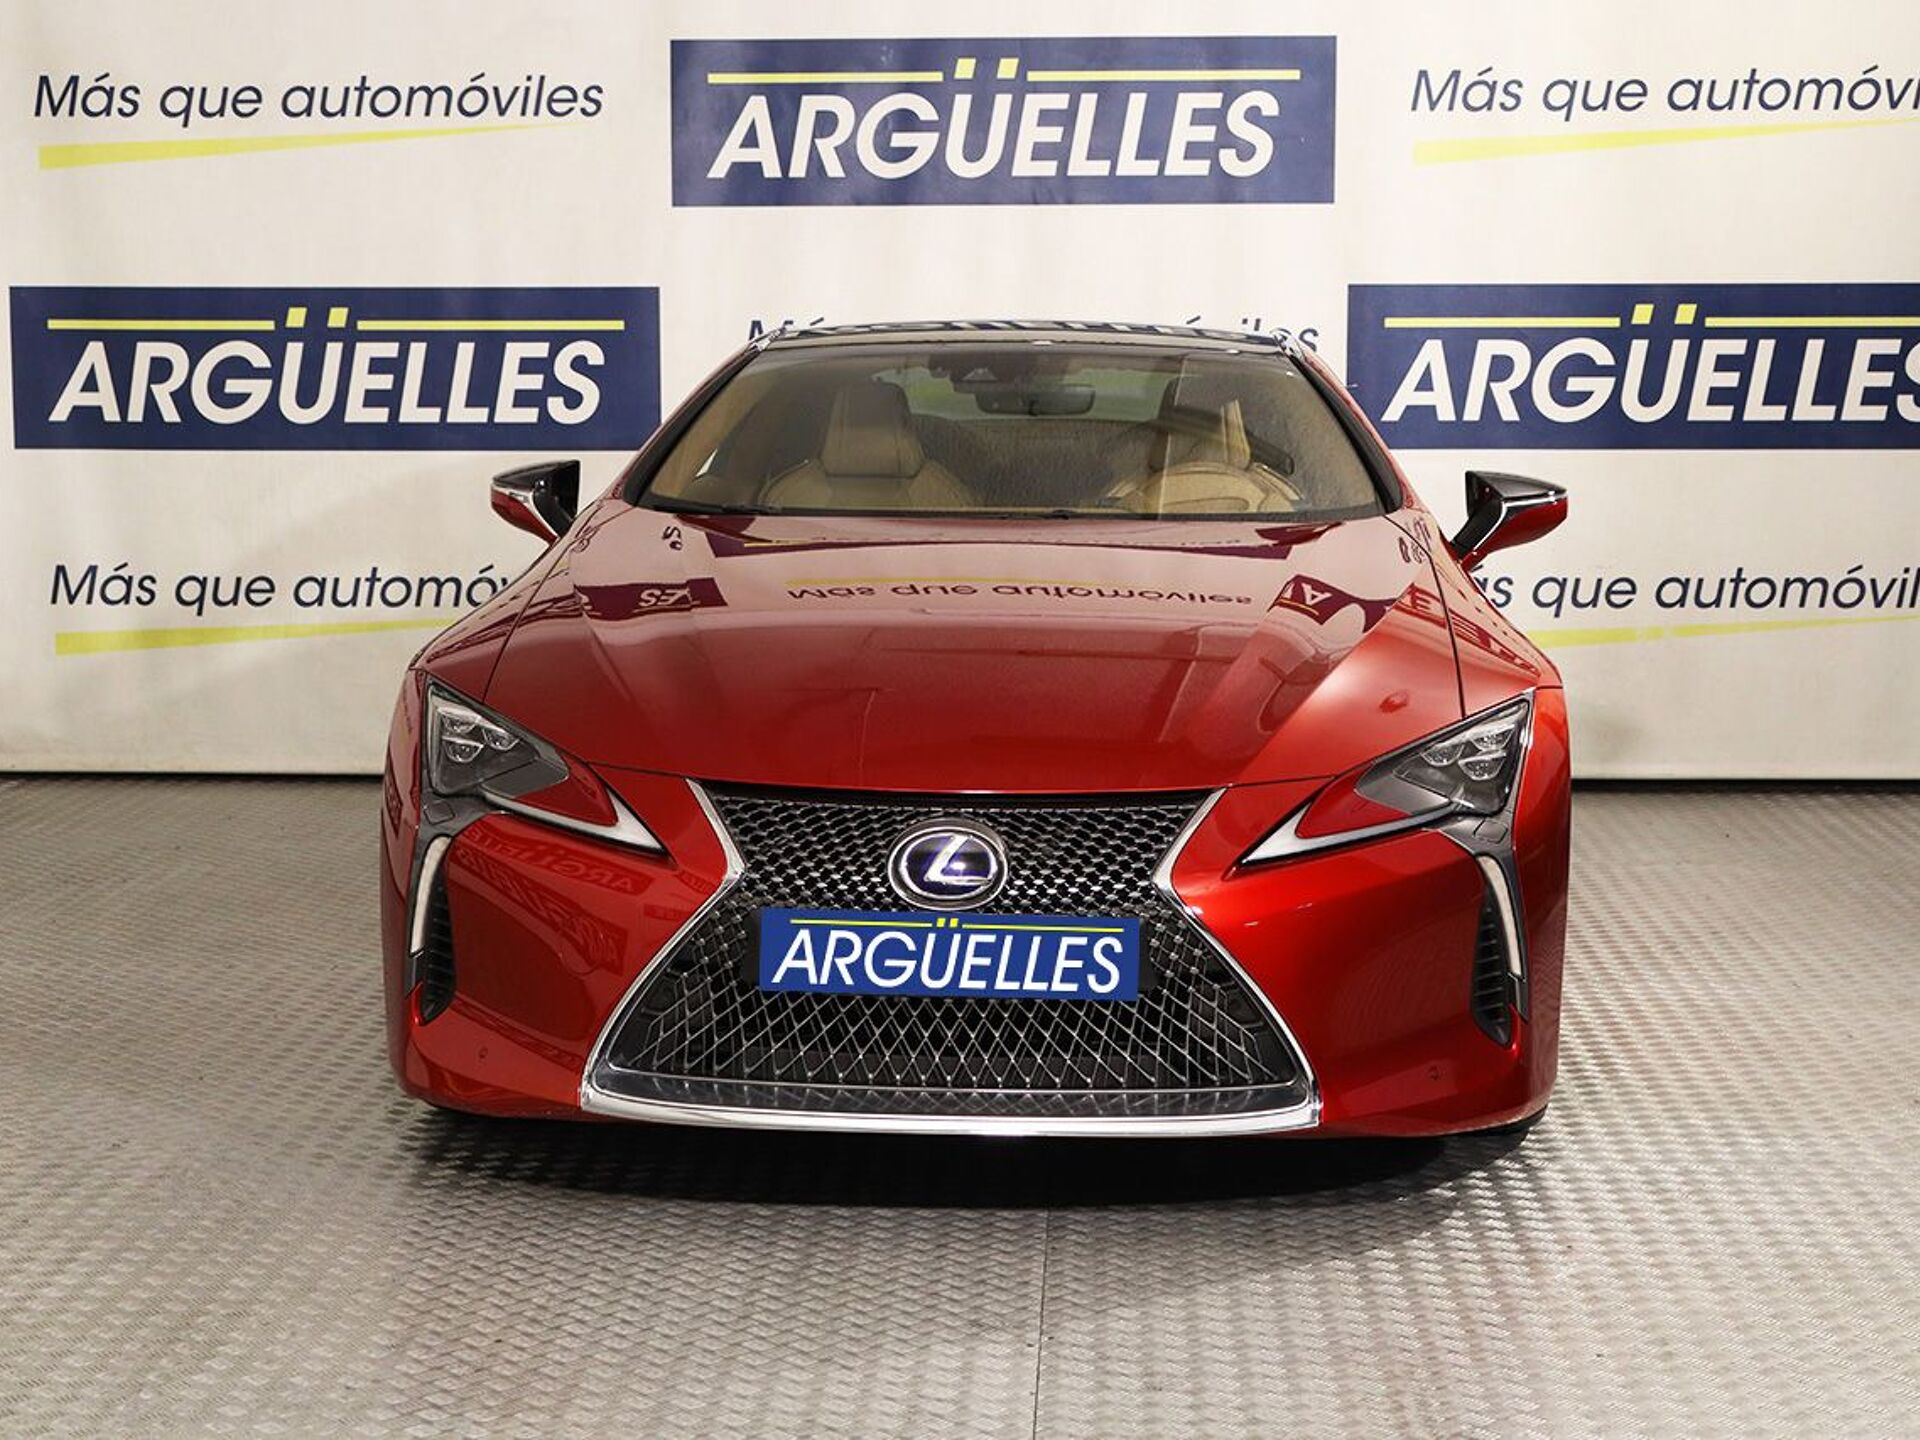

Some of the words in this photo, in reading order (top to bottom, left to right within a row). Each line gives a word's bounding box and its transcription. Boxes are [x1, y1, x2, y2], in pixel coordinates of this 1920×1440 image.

[34, 72, 141, 118] Más
[159, 85, 263, 129] que
[281, 72, 604, 118] automóviles
[706, 57, 1281, 179] ARGÜELLES
[1411, 67, 1523, 112] Más
[1543, 79, 1649, 122] que
[48, 307, 605, 425] ARGÜELLES
[50, 562, 157, 607] Más
[174, 575, 276, 617] que
[293, 564, 508, 608] automó
[1532, 576, 1638, 618] que
